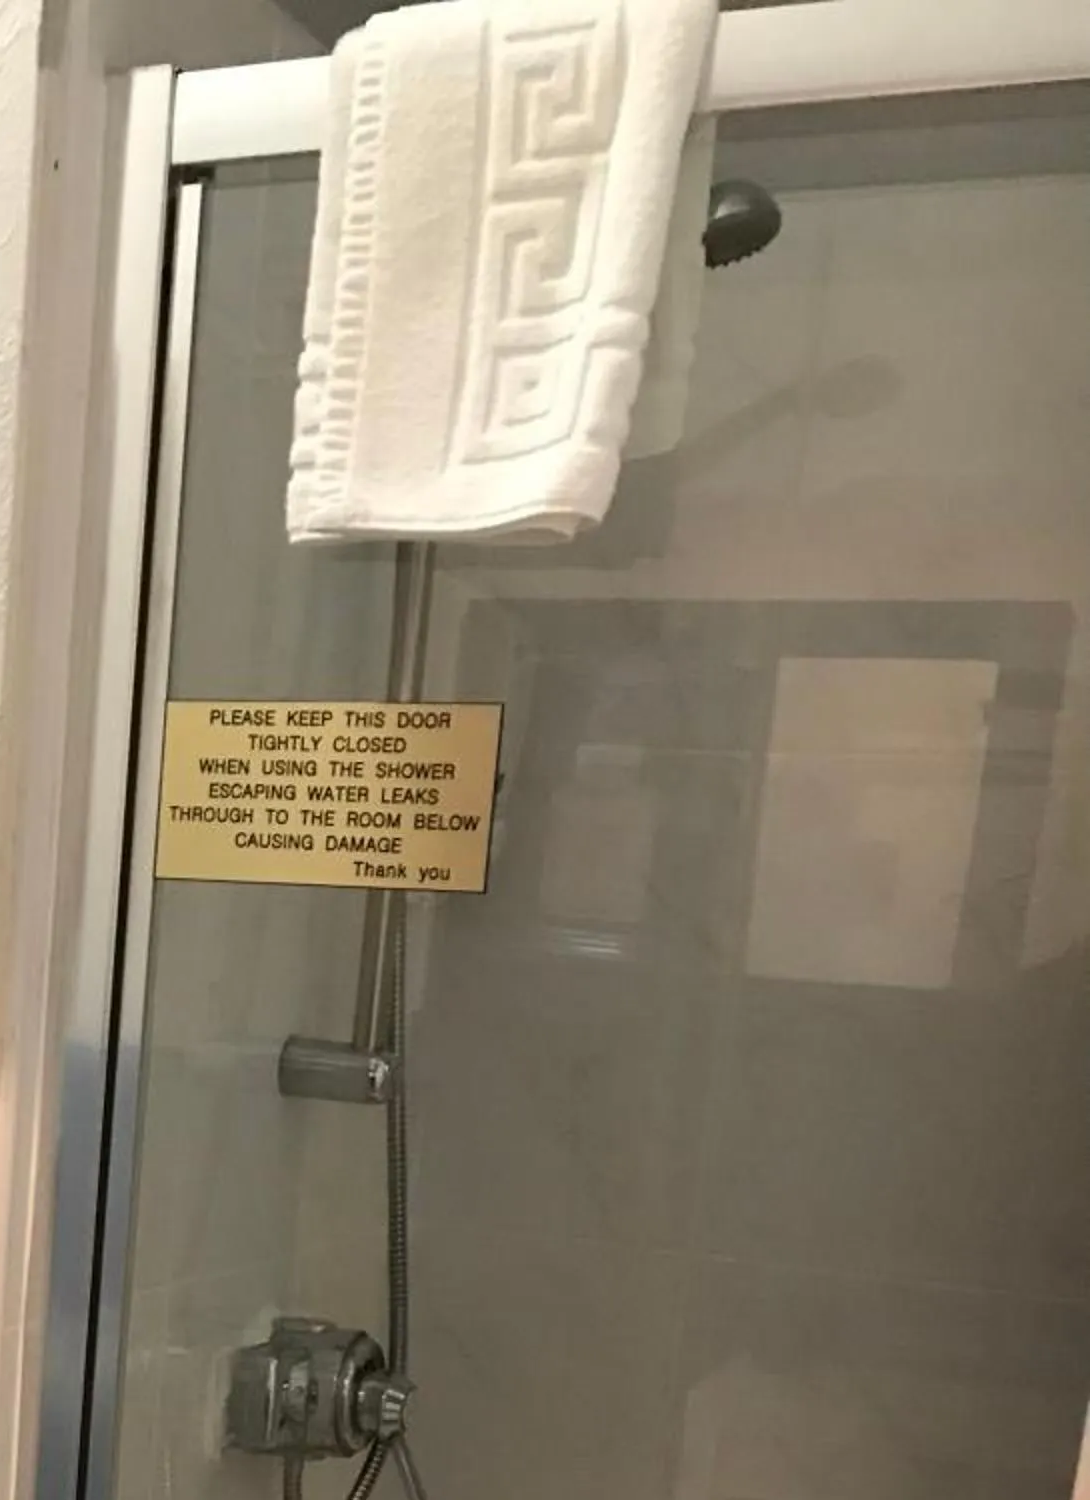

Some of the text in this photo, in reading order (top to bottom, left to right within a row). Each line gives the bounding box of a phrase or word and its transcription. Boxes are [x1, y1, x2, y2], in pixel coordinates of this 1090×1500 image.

[210, 709, 451, 729] PLEASE KEEP THIS DOOR
[248, 733, 407, 753] TIGHTLY CLOSED
[199, 758, 456, 780] WHEN USING THE SHOWER
[209, 783, 440, 805] ESCAPING WATER LEAKS
[170, 805, 480, 831] THROUGH TO THE ROOM BELOW
[235, 832, 403, 853] CAUSING DAMAGE
[354, 861, 451, 883] Thank you
